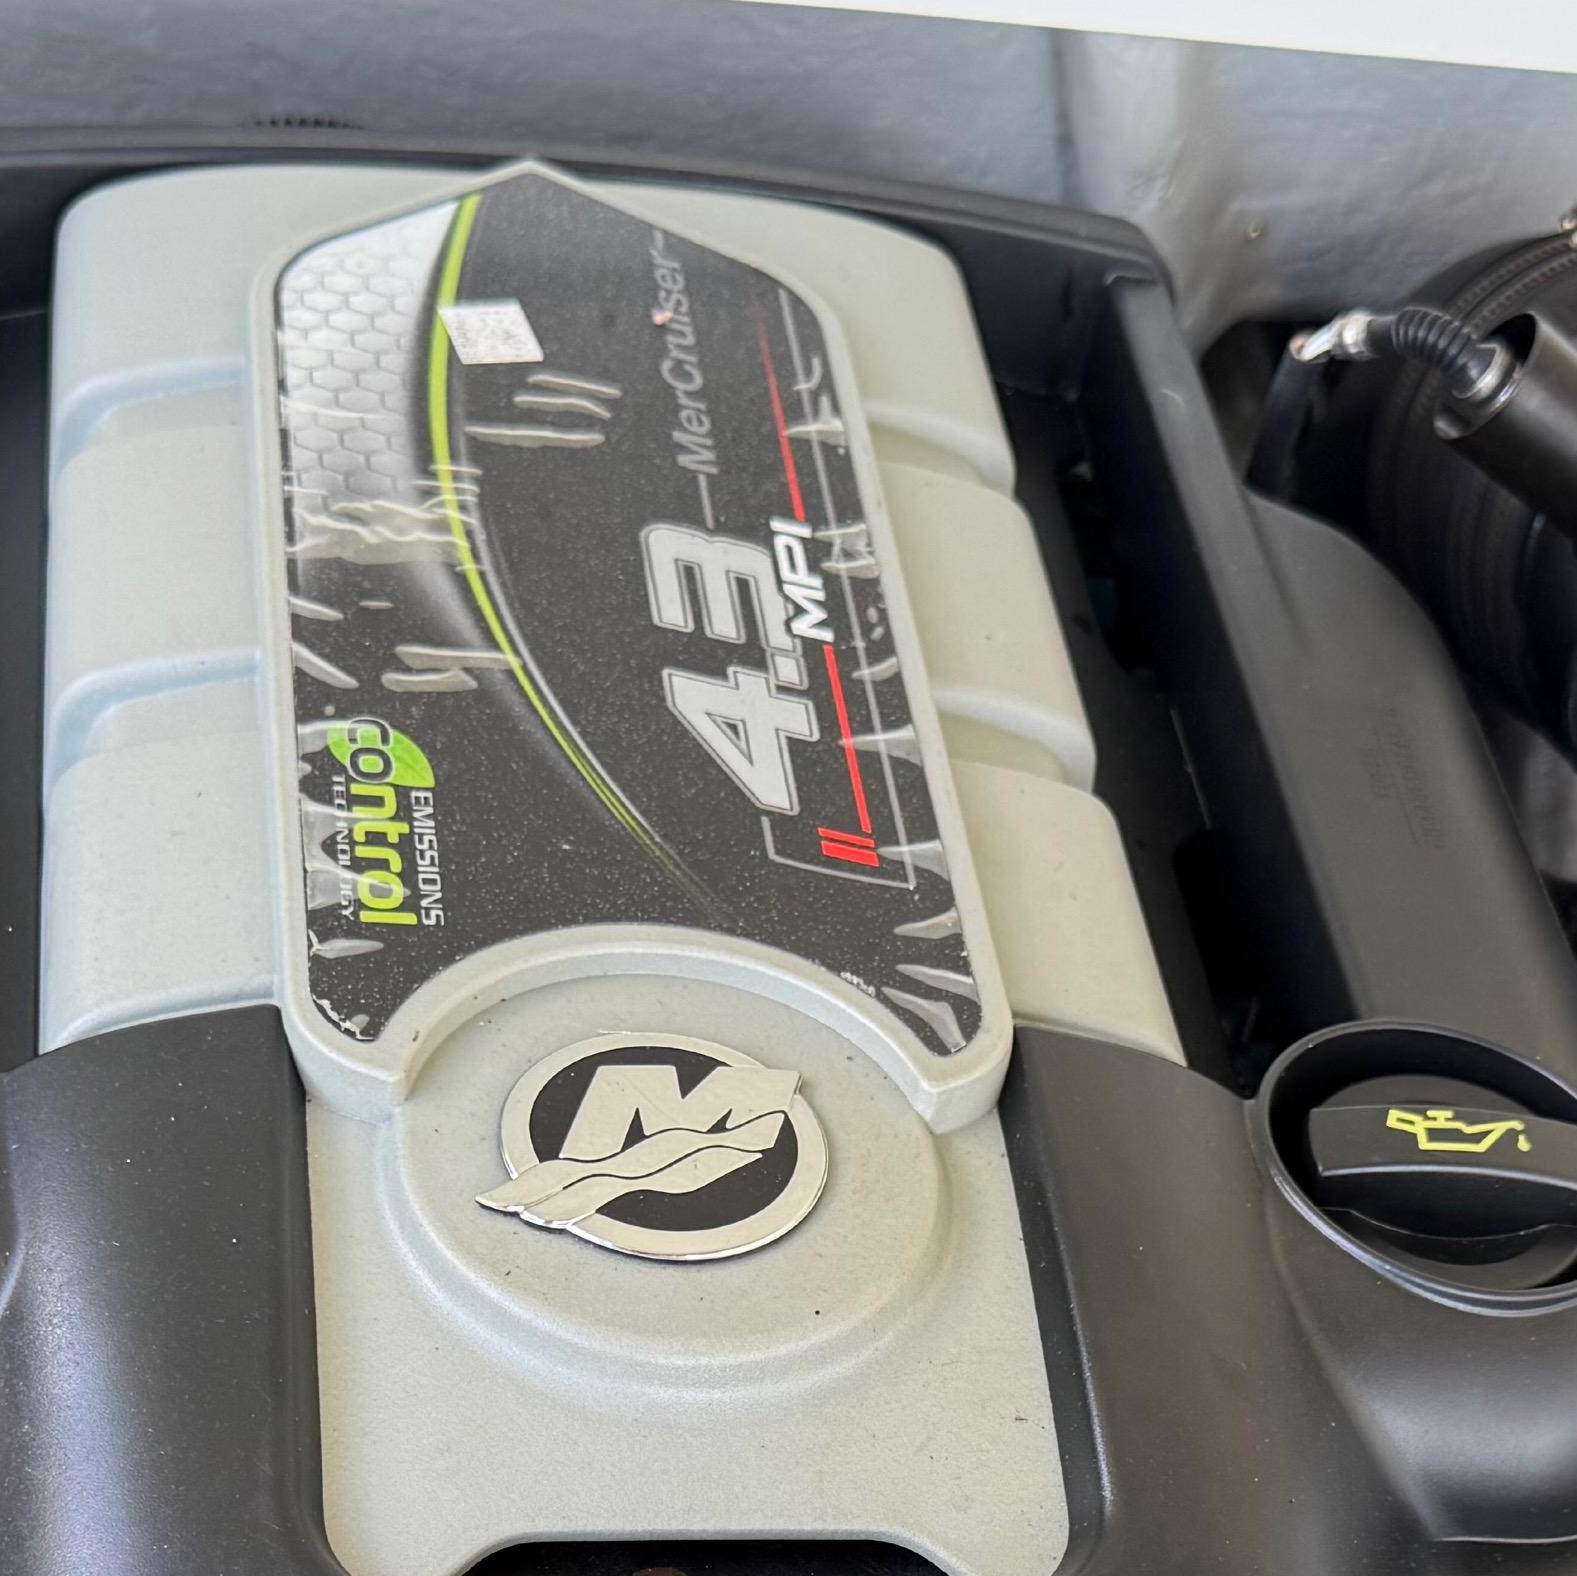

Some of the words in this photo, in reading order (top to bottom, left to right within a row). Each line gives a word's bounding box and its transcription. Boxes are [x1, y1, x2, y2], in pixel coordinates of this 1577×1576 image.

[649, 249, 719, 476] MerCruiser
[639, 523, 821, 817] 4.3
[769, 515, 836, 644] MPI
[346, 716, 419, 926] control
[409, 789, 445, 927] EMISSIONS
